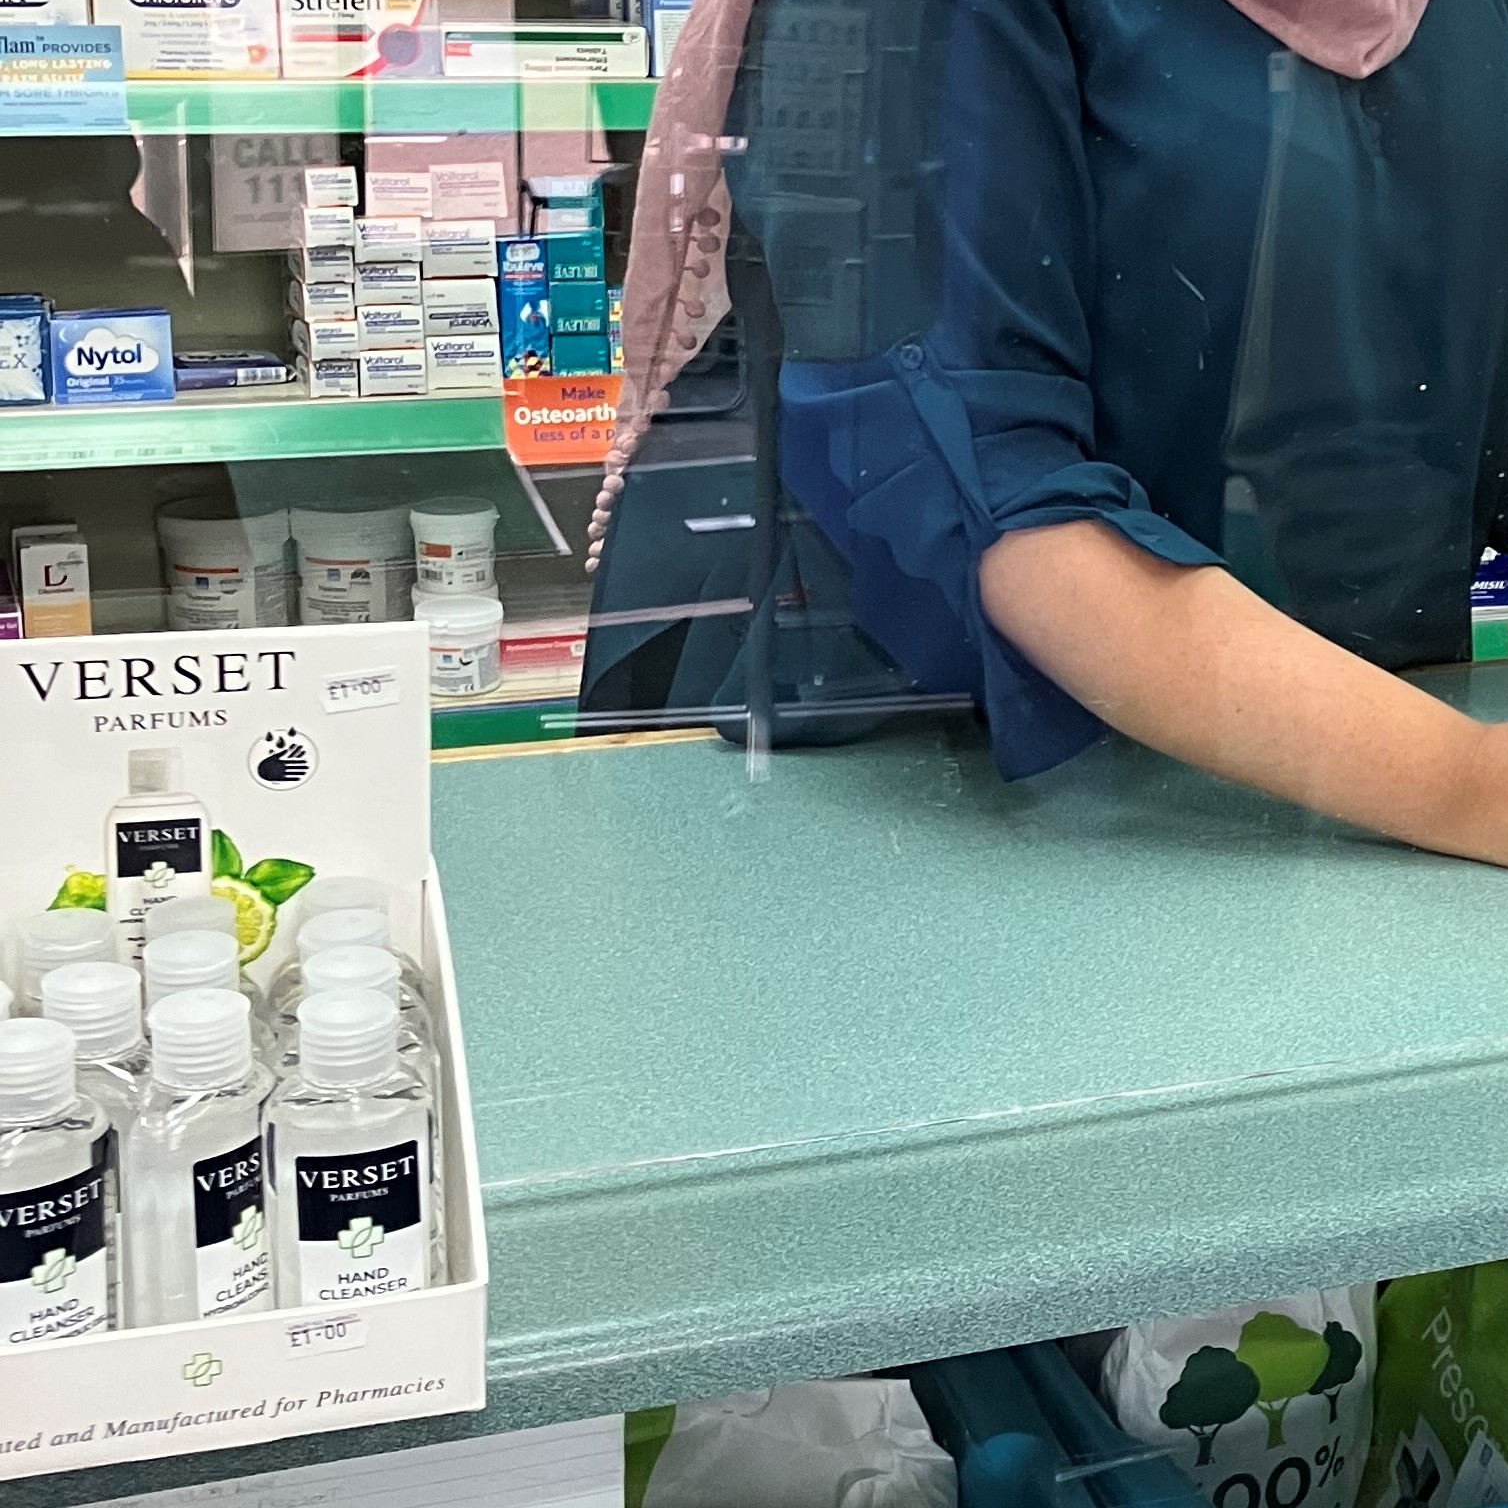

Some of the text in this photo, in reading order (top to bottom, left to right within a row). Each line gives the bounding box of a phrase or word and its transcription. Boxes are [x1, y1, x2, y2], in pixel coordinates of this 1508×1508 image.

[42, 43, 112, 54] PROVIDES
[362, 310, 402, 321] Voltarol
[77, 343, 142, 370] Nytol
[431, 341, 475, 352] Voltarol
[363, 355, 404, 365] Voltarol
[66, 376, 110, 389] Original
[561, 386, 605, 400] Make
[514, 403, 617, 425] Osteoarth
[534, 427, 600, 442] less of a
[19, 651, 297, 702] VERSET
[93, 709, 228, 733] PARFUMS
[118, 826, 200, 843] VERSET
[197, 1152, 260, 1192] VERS
[299, 1155, 415, 1189] VERSET
[330, 1187, 389, 1203] PARFUMS
[24, 1214, 82, 1238] PARFUMS
[216, 1269, 268, 1303] CLEANS
[338, 1266, 390, 1285] HAND
[319, 1277, 408, 1301] CLEANSER
[30, 1298, 80, 1324] HAND
[9, 1306, 96, 1344] CLEANSER
[50, 1425, 96, 1446] and
[103, 1399, 267, 1440] Manufactured
[273, 1395, 308, 1420] for
[316, 1375, 447, 1409] Pharmacies
